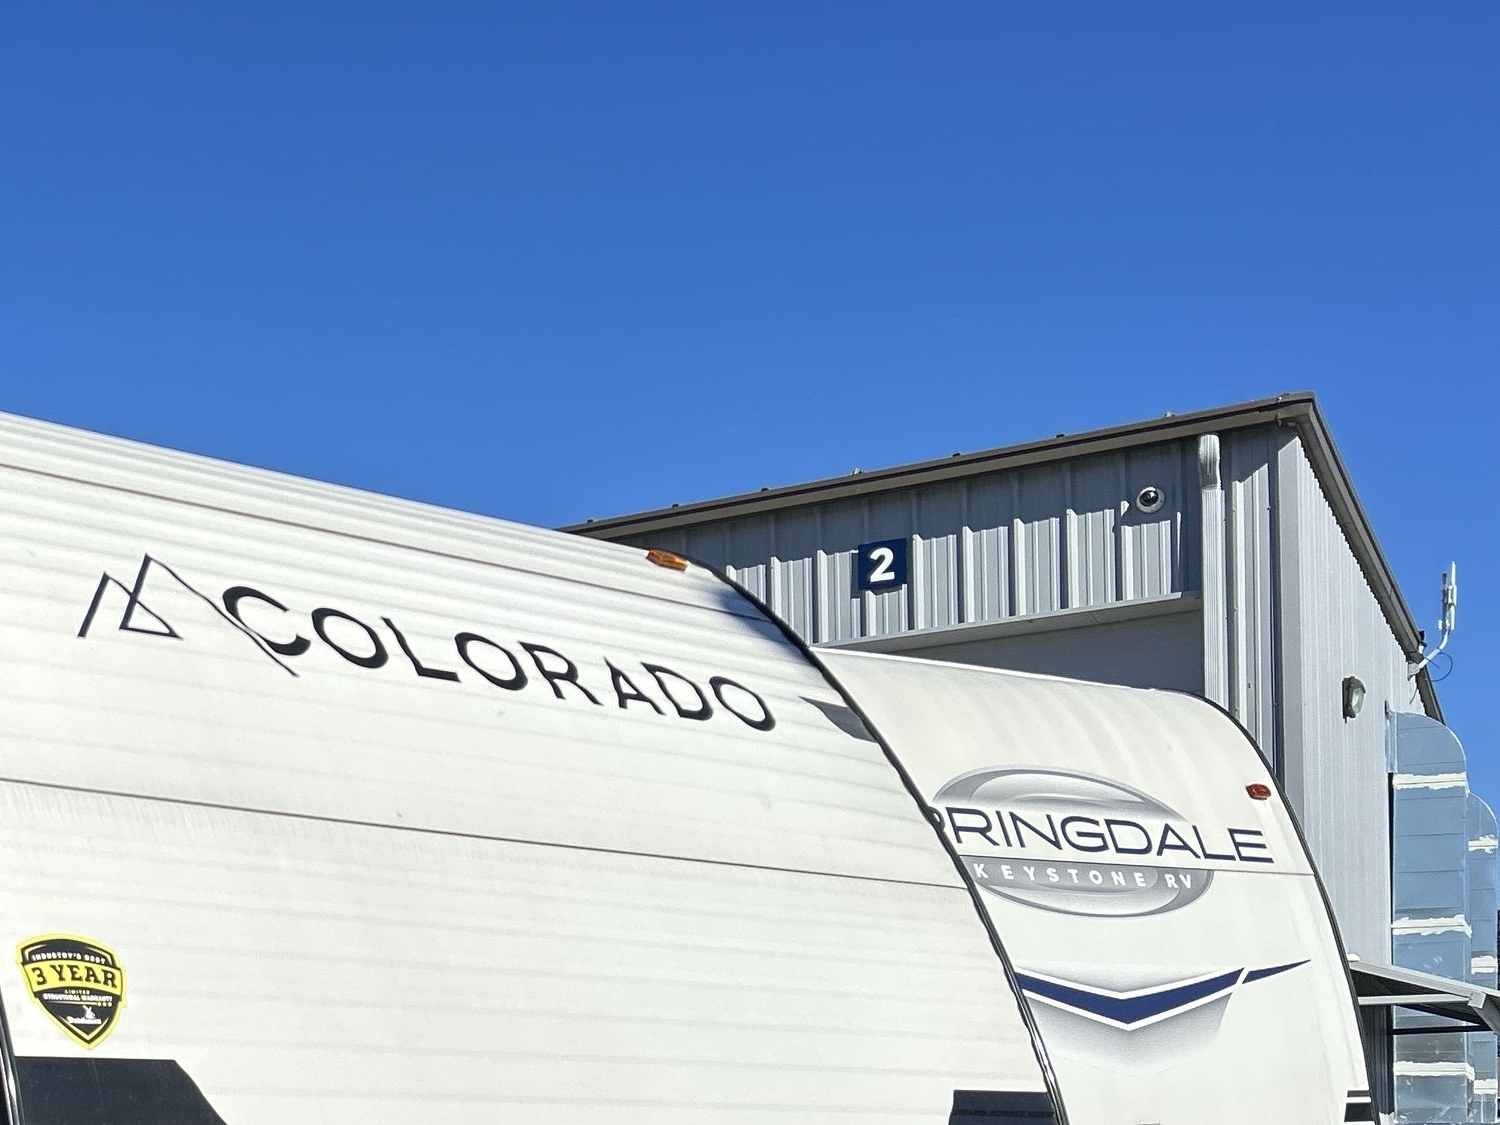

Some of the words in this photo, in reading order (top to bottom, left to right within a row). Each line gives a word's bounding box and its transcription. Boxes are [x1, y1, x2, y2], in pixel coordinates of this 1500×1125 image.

[868, 547, 897, 583] 2
[222, 585, 777, 732] COLORADO
[973, 862, 1148, 888] KEYSTONE
[1165, 872, 1194, 890] RV
[31, 966, 47, 986] 3
[49, 964, 118, 989] YEAR
